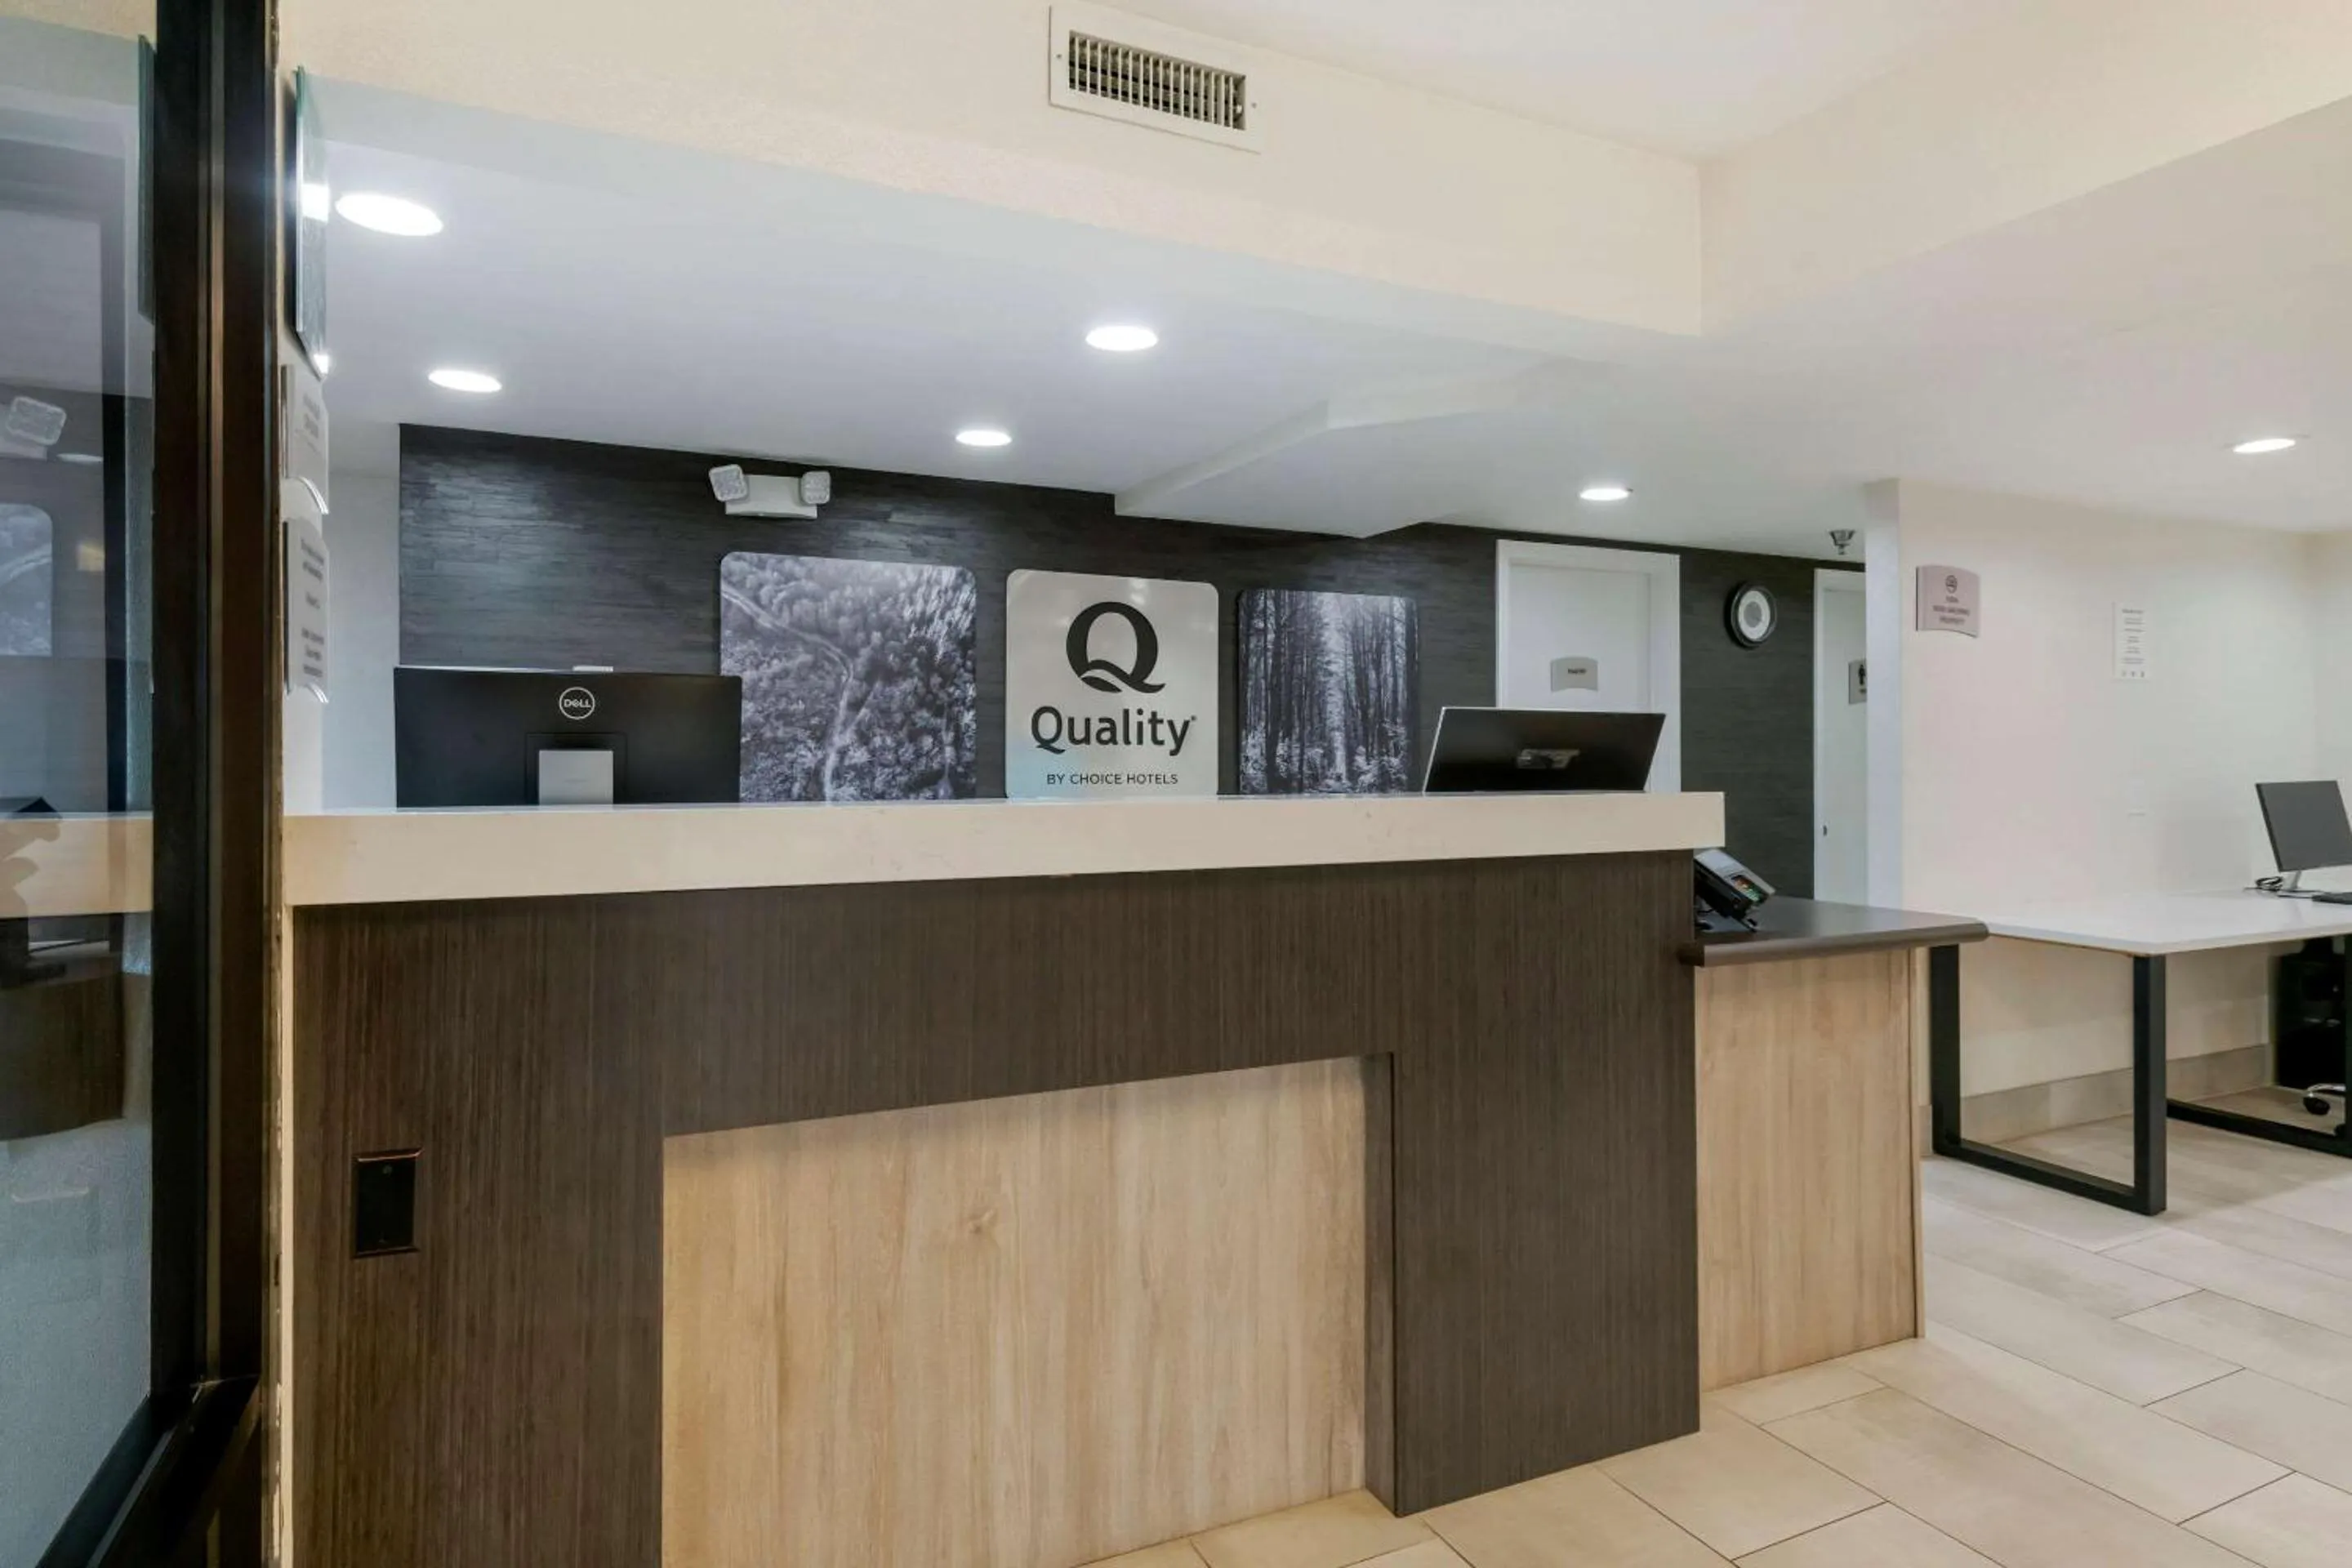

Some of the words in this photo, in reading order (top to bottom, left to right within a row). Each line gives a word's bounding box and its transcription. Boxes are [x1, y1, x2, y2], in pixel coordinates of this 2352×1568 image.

[1066, 601, 1166, 693] Q
[564, 699, 591, 708] DELL
[1031, 706, 1191, 756] Quality
[1047, 774, 1065, 785] BY
[1070, 774, 1122, 785] CHOICE
[1126, 774, 1178, 785] HOTELS
